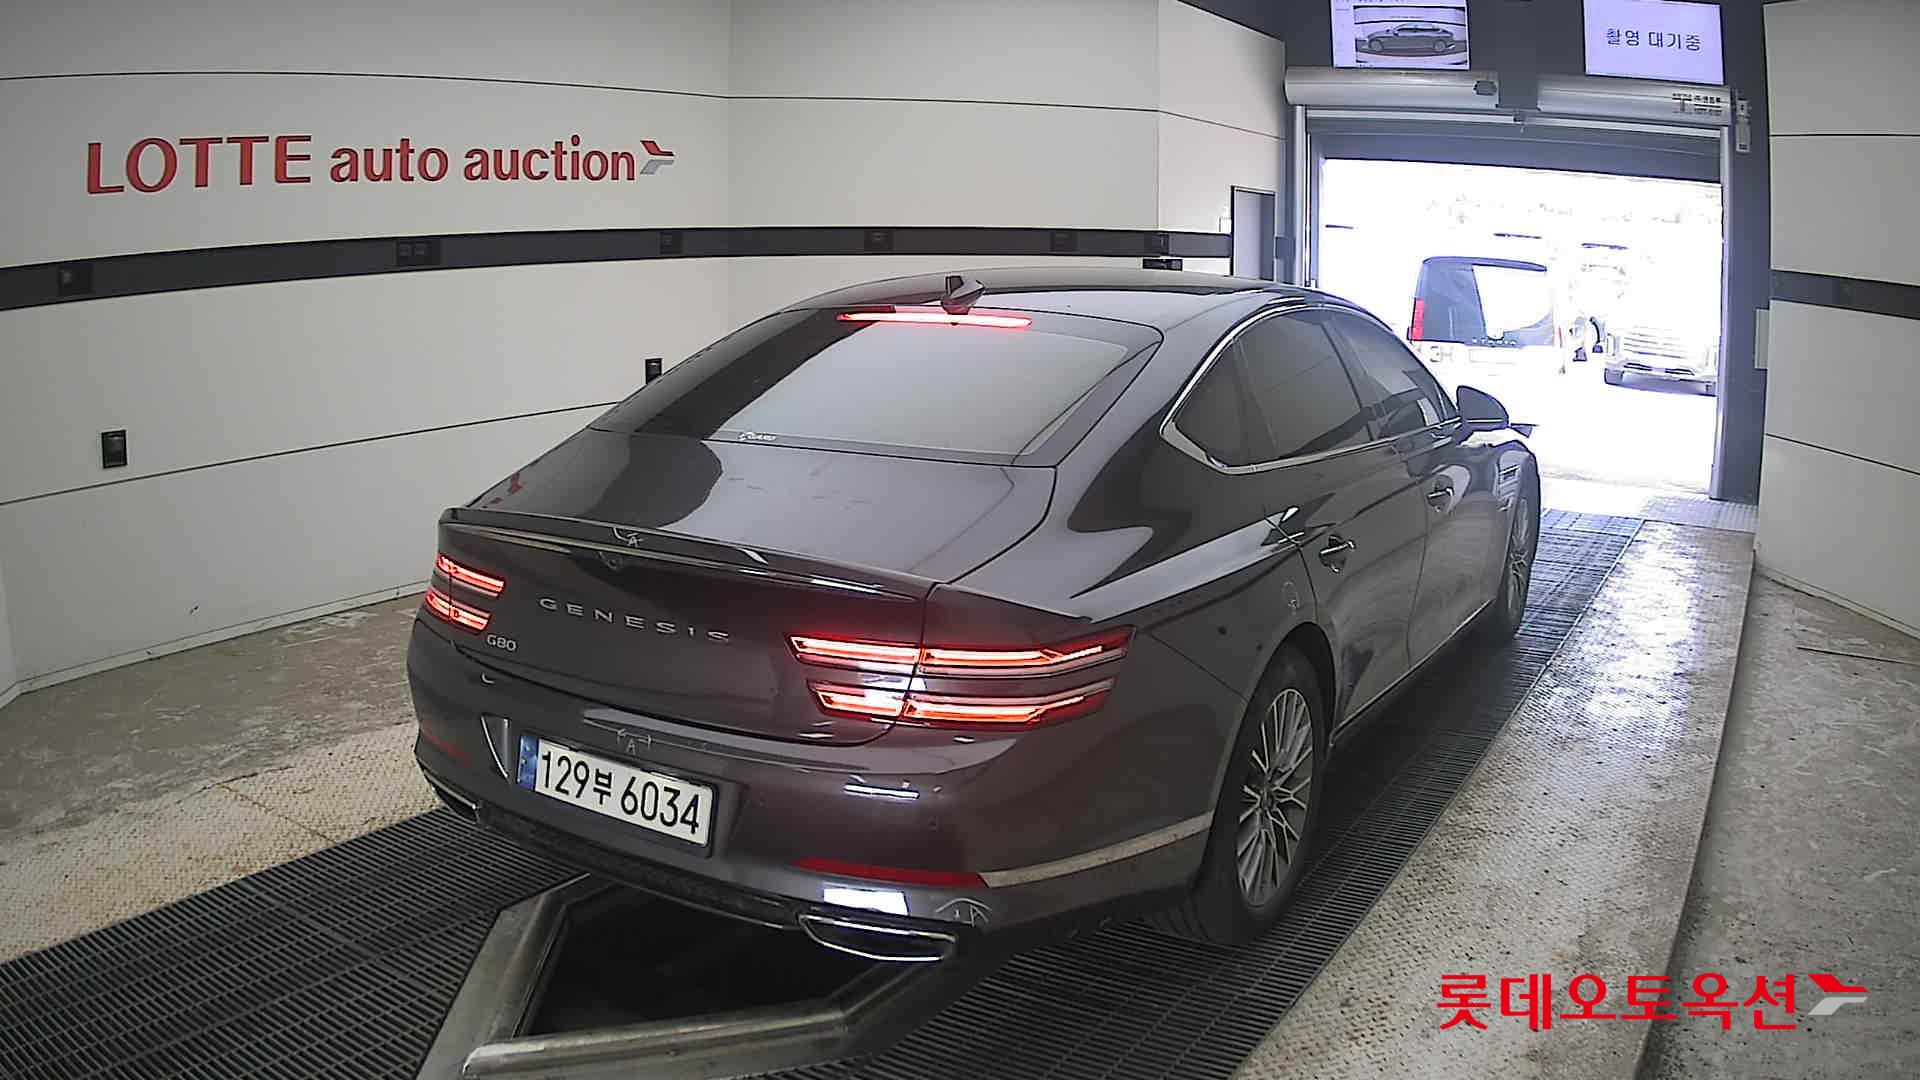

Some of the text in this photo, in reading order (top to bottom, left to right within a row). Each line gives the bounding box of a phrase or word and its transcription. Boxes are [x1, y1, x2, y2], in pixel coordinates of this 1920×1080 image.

[1648, 31, 1701, 52] 대기중
[87, 134, 635, 194] LOTTE auto auction
[539, 598, 729, 642] GENESIS
[487, 634, 517, 651] G80
[541, 751, 700, 835] 129부 6034
